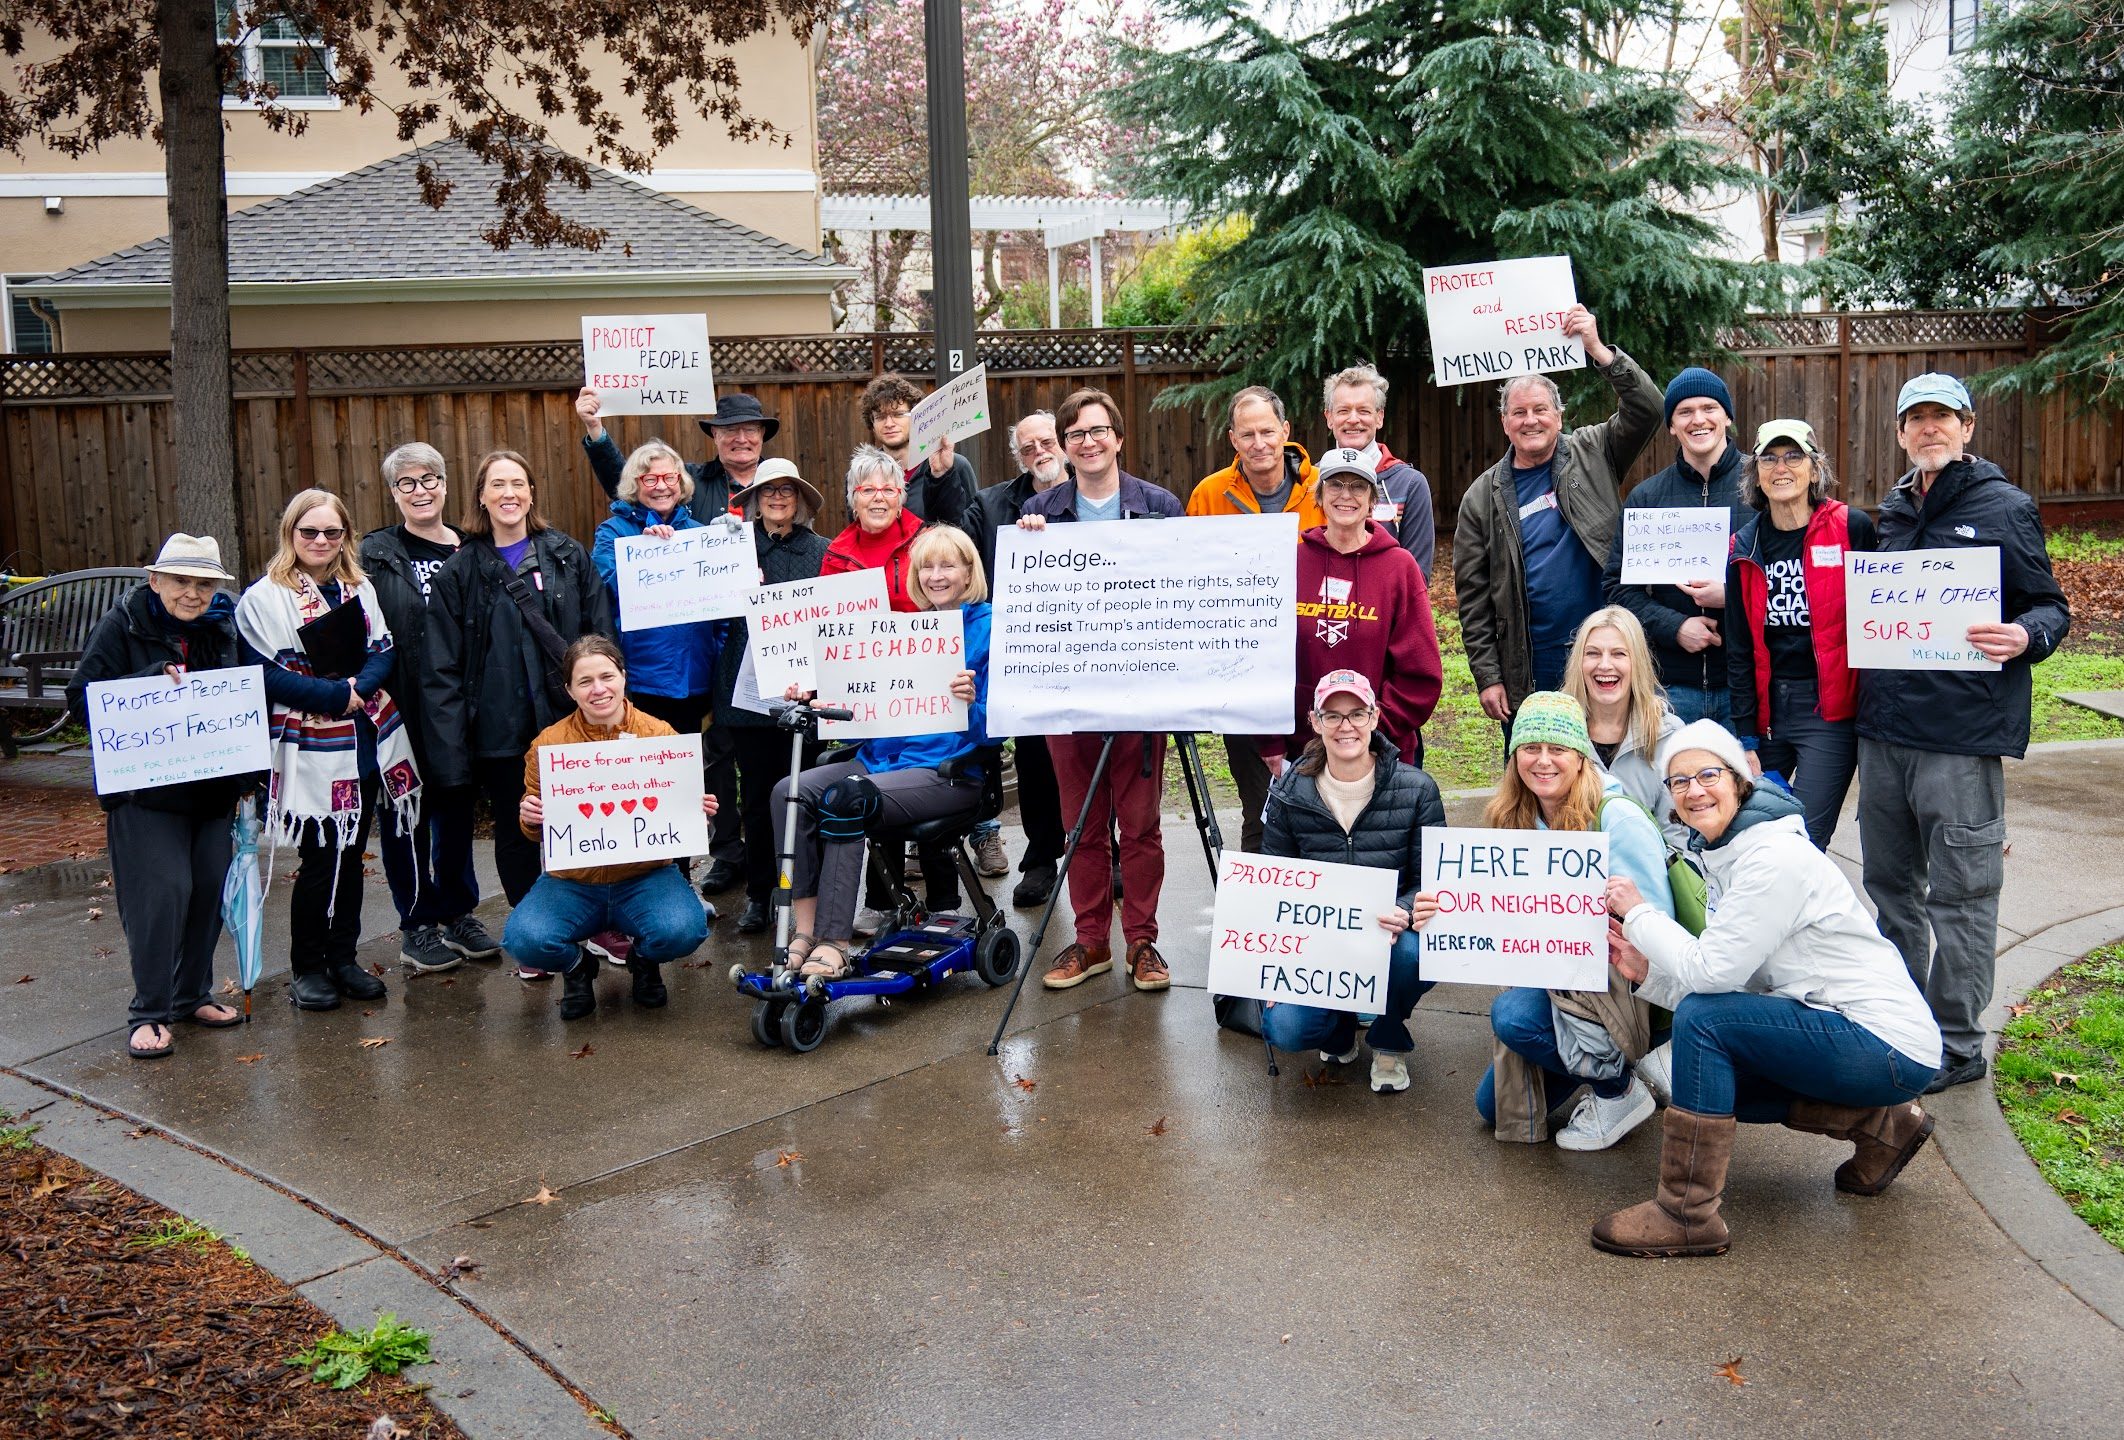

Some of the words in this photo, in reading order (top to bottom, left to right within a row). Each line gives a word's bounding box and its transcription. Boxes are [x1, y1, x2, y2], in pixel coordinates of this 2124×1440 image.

[1430, 271, 1494, 294] PROTECT
[1473, 296, 1504, 315] and
[1504, 311, 1570, 336] RESIST
[592, 327, 656, 351] PROTECT
[640, 350, 699, 369] PEOPLE
[952, 353, 961, 369] 2
[1443, 350, 1513, 381] MENLO
[1524, 344, 1578, 371] PARK
[593, 374, 649, 388] RESIST
[640, 389, 689, 405] HATE
[918, 407, 948, 434] RESIST
[953, 392, 979, 411] HATE
[1628, 511, 1654, 521] HERE
[1661, 511, 1681, 519] FOR
[1628, 525, 1652, 536] OUR
[1657, 522, 1722, 535] NEIGHBORS
[626, 540, 694, 562] PROTECT
[700, 532, 749, 549] PEOPLE
[1627, 543, 1655, 554] HERE
[1660, 541, 1683, 551] FOR
[411, 560, 445, 573] HO
[1011, 552, 1015, 570] I
[1023, 549, 1117, 573] pledge...
[1627, 558, 1660, 567] EACH
[1667, 557, 1712, 567] OTHER
[1765, 558, 1804, 580] HOW
[1854, 558, 1905, 575] HERE
[1920, 560, 1956, 572] FOR
[638, 568, 685, 590] RESIST
[693, 560, 740, 577] TRUMP
[1008, 583, 1021, 593] to
[1025, 581, 1061, 593] show
[1064, 582, 1083, 594] up
[1086, 581, 1100, 591] to
[1104, 578, 1156, 593] protect
[1160, 577, 1184, 589] the
[1188, 575, 1232, 591] rights,
[1236, 574, 1280, 589] safety
[1780, 576, 1805, 594] FO
[749, 590, 783, 606] WE'RE
[792, 586, 815, 599] NOT
[1006, 602, 1032, 614] and
[1036, 600, 1083, 615] dignity
[1086, 599, 1101, 611] of
[1104, 598, 1152, 613] people
[1156, 597, 1168, 609] in
[1173, 599, 1196, 611] my
[1198, 594, 1283, 609] community
[1870, 587, 1927, 604] EACH
[1940, 587, 2000, 604] OTHER
[762, 605, 830, 631] BACKING
[836, 597, 879, 616] DOWN
[817, 622, 855, 638] HERE
[870, 619, 897, 634] FOR
[911, 618, 940, 632] OUR
[1005, 621, 1031, 633] and
[1035, 620, 1073, 633] resist
[1077, 619, 1133, 633] Trump's
[1136, 616, 1246, 630] antidemocratic
[1250, 616, 1278, 628] and
[1863, 620, 1933, 641] SURJ
[761, 641, 797, 657] JOIN
[825, 635, 960, 661] NEIGHBORS
[1005, 641, 1061, 654] immoral
[1065, 640, 1117, 655] agenda
[1121, 638, 1194, 651] consistent
[1198, 637, 1230, 650] with
[1235, 637, 1259, 649] the
[1912, 649, 1961, 661] MENLO
[1967, 651, 1989, 661] PAR
[788, 657, 809, 668] THE
[1004, 661, 1070, 676] principles
[1073, 661, 1088, 673] of
[1091, 660, 1179, 673] nonviolence.
[101, 686, 188, 712] PROTECT
[191, 679, 252, 700] PEOPLE
[847, 681, 876, 694] HERE
[889, 679, 914, 690] FOR
[889, 695, 953, 718] OTHER
[98, 722, 182, 752] RESIST
[186, 710, 260, 737] FASCISM
[167, 755, 197, 766] EACH
[550, 752, 591, 772] Here
[595, 752, 612, 766] for
[615, 757, 634, 765] our
[640, 750, 695, 765] neighbors
[551, 783, 585, 797] Here
[587, 781, 606, 792] for
[611, 779, 640, 791] each
[643, 778, 676, 790] other
[549, 824, 617, 858] Menlo
[633, 817, 681, 848] Park
[1436, 842, 1529, 881] HERE
[1547, 847, 1607, 879] FOR
[1224, 862, 1323, 889] PROTECT
[1436, 890, 1485, 913] OUR
[1491, 894, 1608, 916] NEIGHBORS
[1276, 901, 1363, 930] PEOPLE
[1220, 929, 1309, 954] RESIST
[1426, 933, 1467, 951] HERE
[1469, 935, 1496, 951] FOR
[1502, 939, 1540, 953] EACH
[1546, 939, 1594, 956] OTHER
[1260, 965, 1376, 1003] FASCISM
